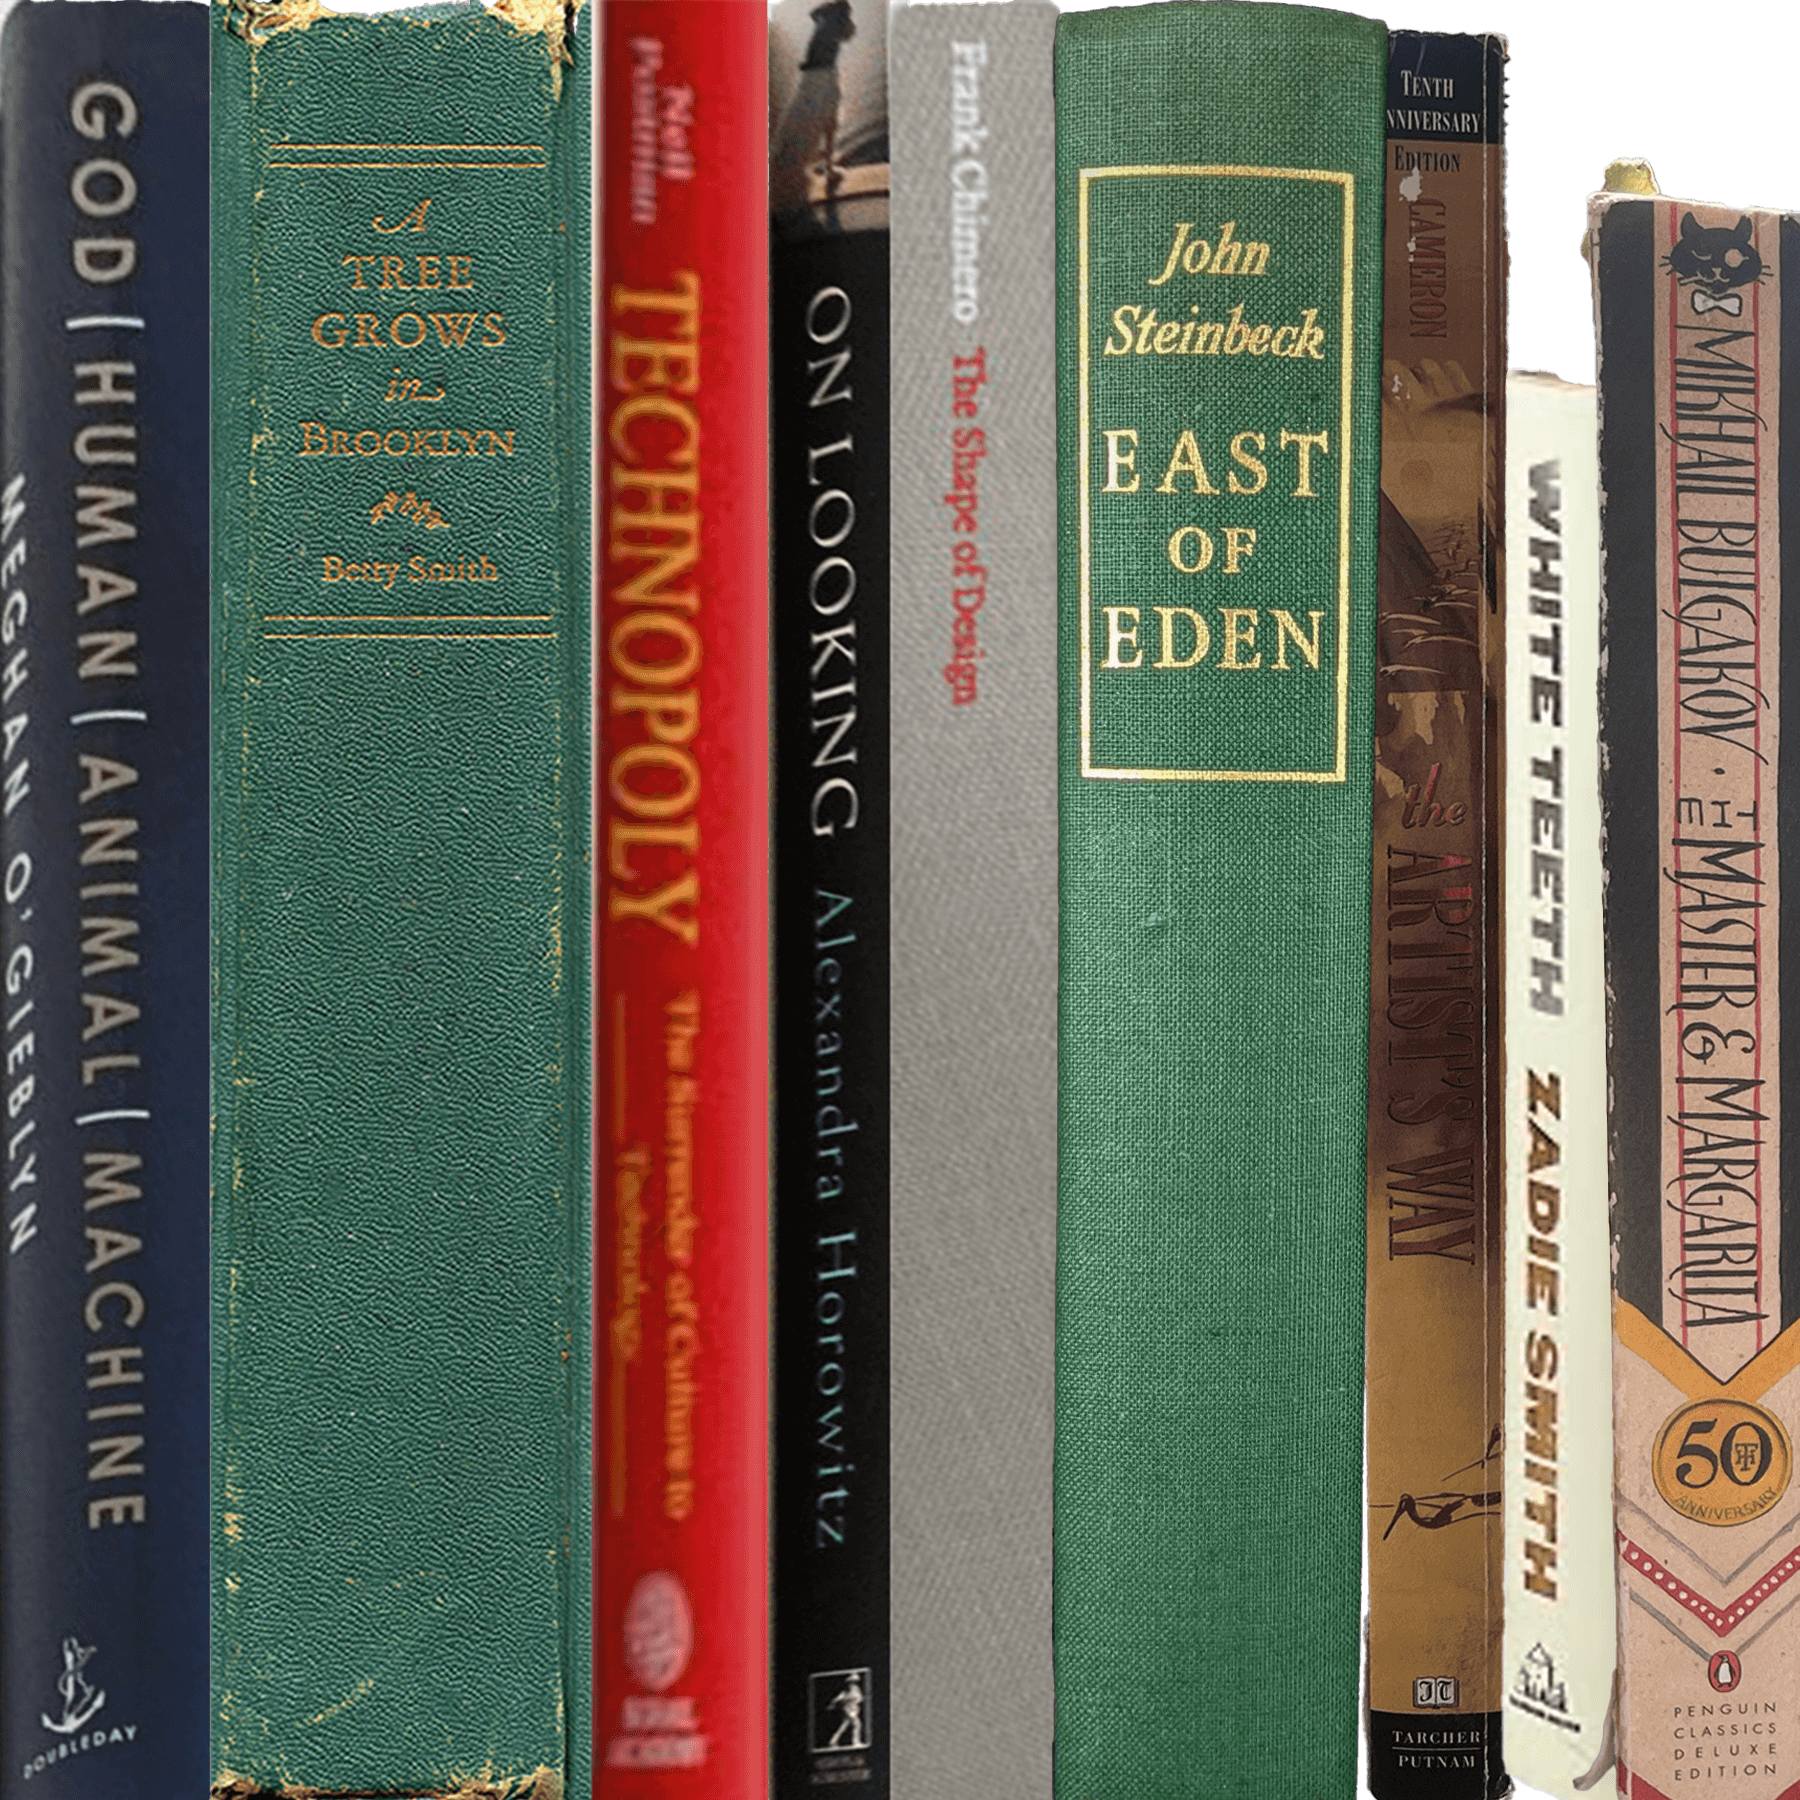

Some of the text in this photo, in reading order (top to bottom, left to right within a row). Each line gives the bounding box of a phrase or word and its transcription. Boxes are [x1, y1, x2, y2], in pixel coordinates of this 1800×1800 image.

[1387, 108, 1481, 134] NNIVERSARY
[371, 199, 433, 233] A
[340, 255, 475, 290] TREE
[1149, 222, 1271, 287] John
[1409, 197, 1448, 339] CAMERON
[311, 312, 507, 349] GROWS
[1103, 302, 1325, 361] Steinbeck
[384, 368, 446, 403] in
[945, 40, 990, 707] Frank Chimero The Shape of Design
[298, 421, 516, 458] BROOKLYN
[1103, 428, 1329, 497] EAST
[320, 554, 499, 588] Betty Smith
[1168, 526, 1258, 577] OF
[1659, 324, 1768, 766] MIKHAIL BULGAKOV
[608, 270, 702, 945] TECHNOPOLY
[0, 473, 30, 815] MEGHAN
[1102, 605, 1325, 673] EDEN
[71, 82, 146, 1529] GOD HUMAN ANIMAL MACHINE
[1402, 760, 1467, 830] the
[806, 286, 859, 1550] ON LOOKING Alexandra Horowitz
[1663, 838, 1766, 1016] MASTER
[1521, 457, 1565, 1602] WHITE TEETH ZADIE SMITH
[1680, 1022, 1757, 1066] &
[1386, 1142, 1476, 1267] WAY
[1665, 1076, 1770, 1330] MARGARITA
[1676, 1418, 1773, 1489] 50
[1672, 1486, 1778, 1520] ANNIVERSARY
[1392, 1730, 1481, 1745] TARCHER
[1674, 1702, 1778, 1718] PENGUIN
[1674, 1723, 1778, 1738] CLASSICS
[22, 1723, 138, 1780] DOUBLEDAY
[1398, 1754, 1475, 1768] PUTNAM
[1674, 1743, 1778, 1759] DELUXE
[1674, 1764, 1778, 1781] EDITION
